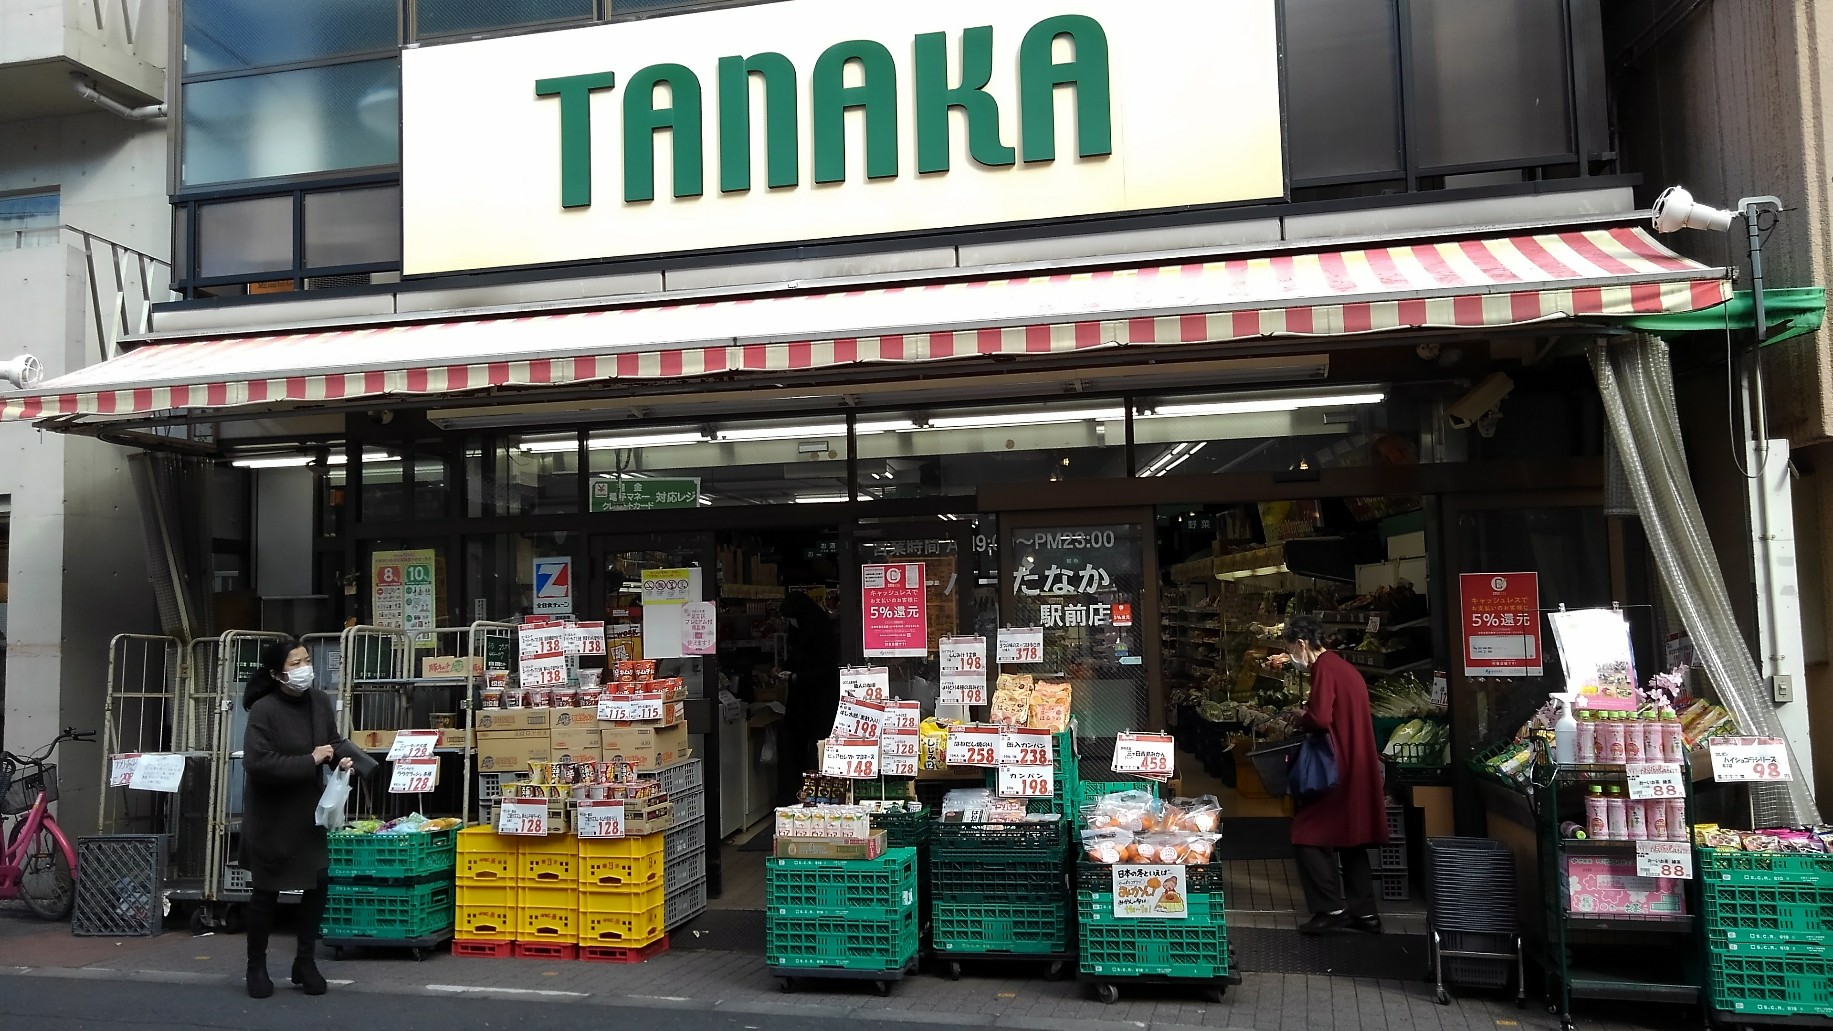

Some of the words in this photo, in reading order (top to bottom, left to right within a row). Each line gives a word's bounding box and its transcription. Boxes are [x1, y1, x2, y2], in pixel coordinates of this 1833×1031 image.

[534, 13, 1112, 210] TANAKA
[655, 491, 697, 503] 対応レジ
[1187, 519, 1212, 530] 野菜
[873, 537, 941, 557] 営業時間
[1013, 563, 1110, 596] たなか
[870, 589, 919, 597] キャッシュレスで
[536, 601, 570, 609] 全日食チェーン
[870, 605, 919, 619] 5%還元
[1040, 602, 1112, 628] 駅前店
[1471, 613, 1530, 627] 5%還元
[540, 639, 561, 653] 138
[582, 640, 602, 653] 138
[1015, 647, 1038, 661] 378
[960, 656, 981, 670] 198
[540, 669, 561, 684] 138
[865, 687, 883, 701] 98
[960, 689, 982, 703] 198
[609, 709, 626, 719] 115
[642, 708, 659, 718] 115
[854, 719, 878, 739] 198
[896, 716, 916, 728] 128
[408, 747, 428, 757] 128
[896, 743, 915, 755] 128
[927, 738, 937, 761] しじみ
[1006, 741, 1046, 749] 缶入カンパン
[967, 747, 995, 764] 258
[1019, 749, 1048, 765] 238
[846, 760, 873, 777] 148
[895, 763, 915, 775] 128
[1140, 757, 1167, 770] 458
[1752, 762, 1781, 778] 98
[407, 777, 430, 791] 128
[1021, 779, 1048, 795] 198
[1653, 785, 1677, 796] 88
[521, 819, 542, 833] 128
[598, 821, 619, 835] 128
[1661, 864, 1685, 877] 88
